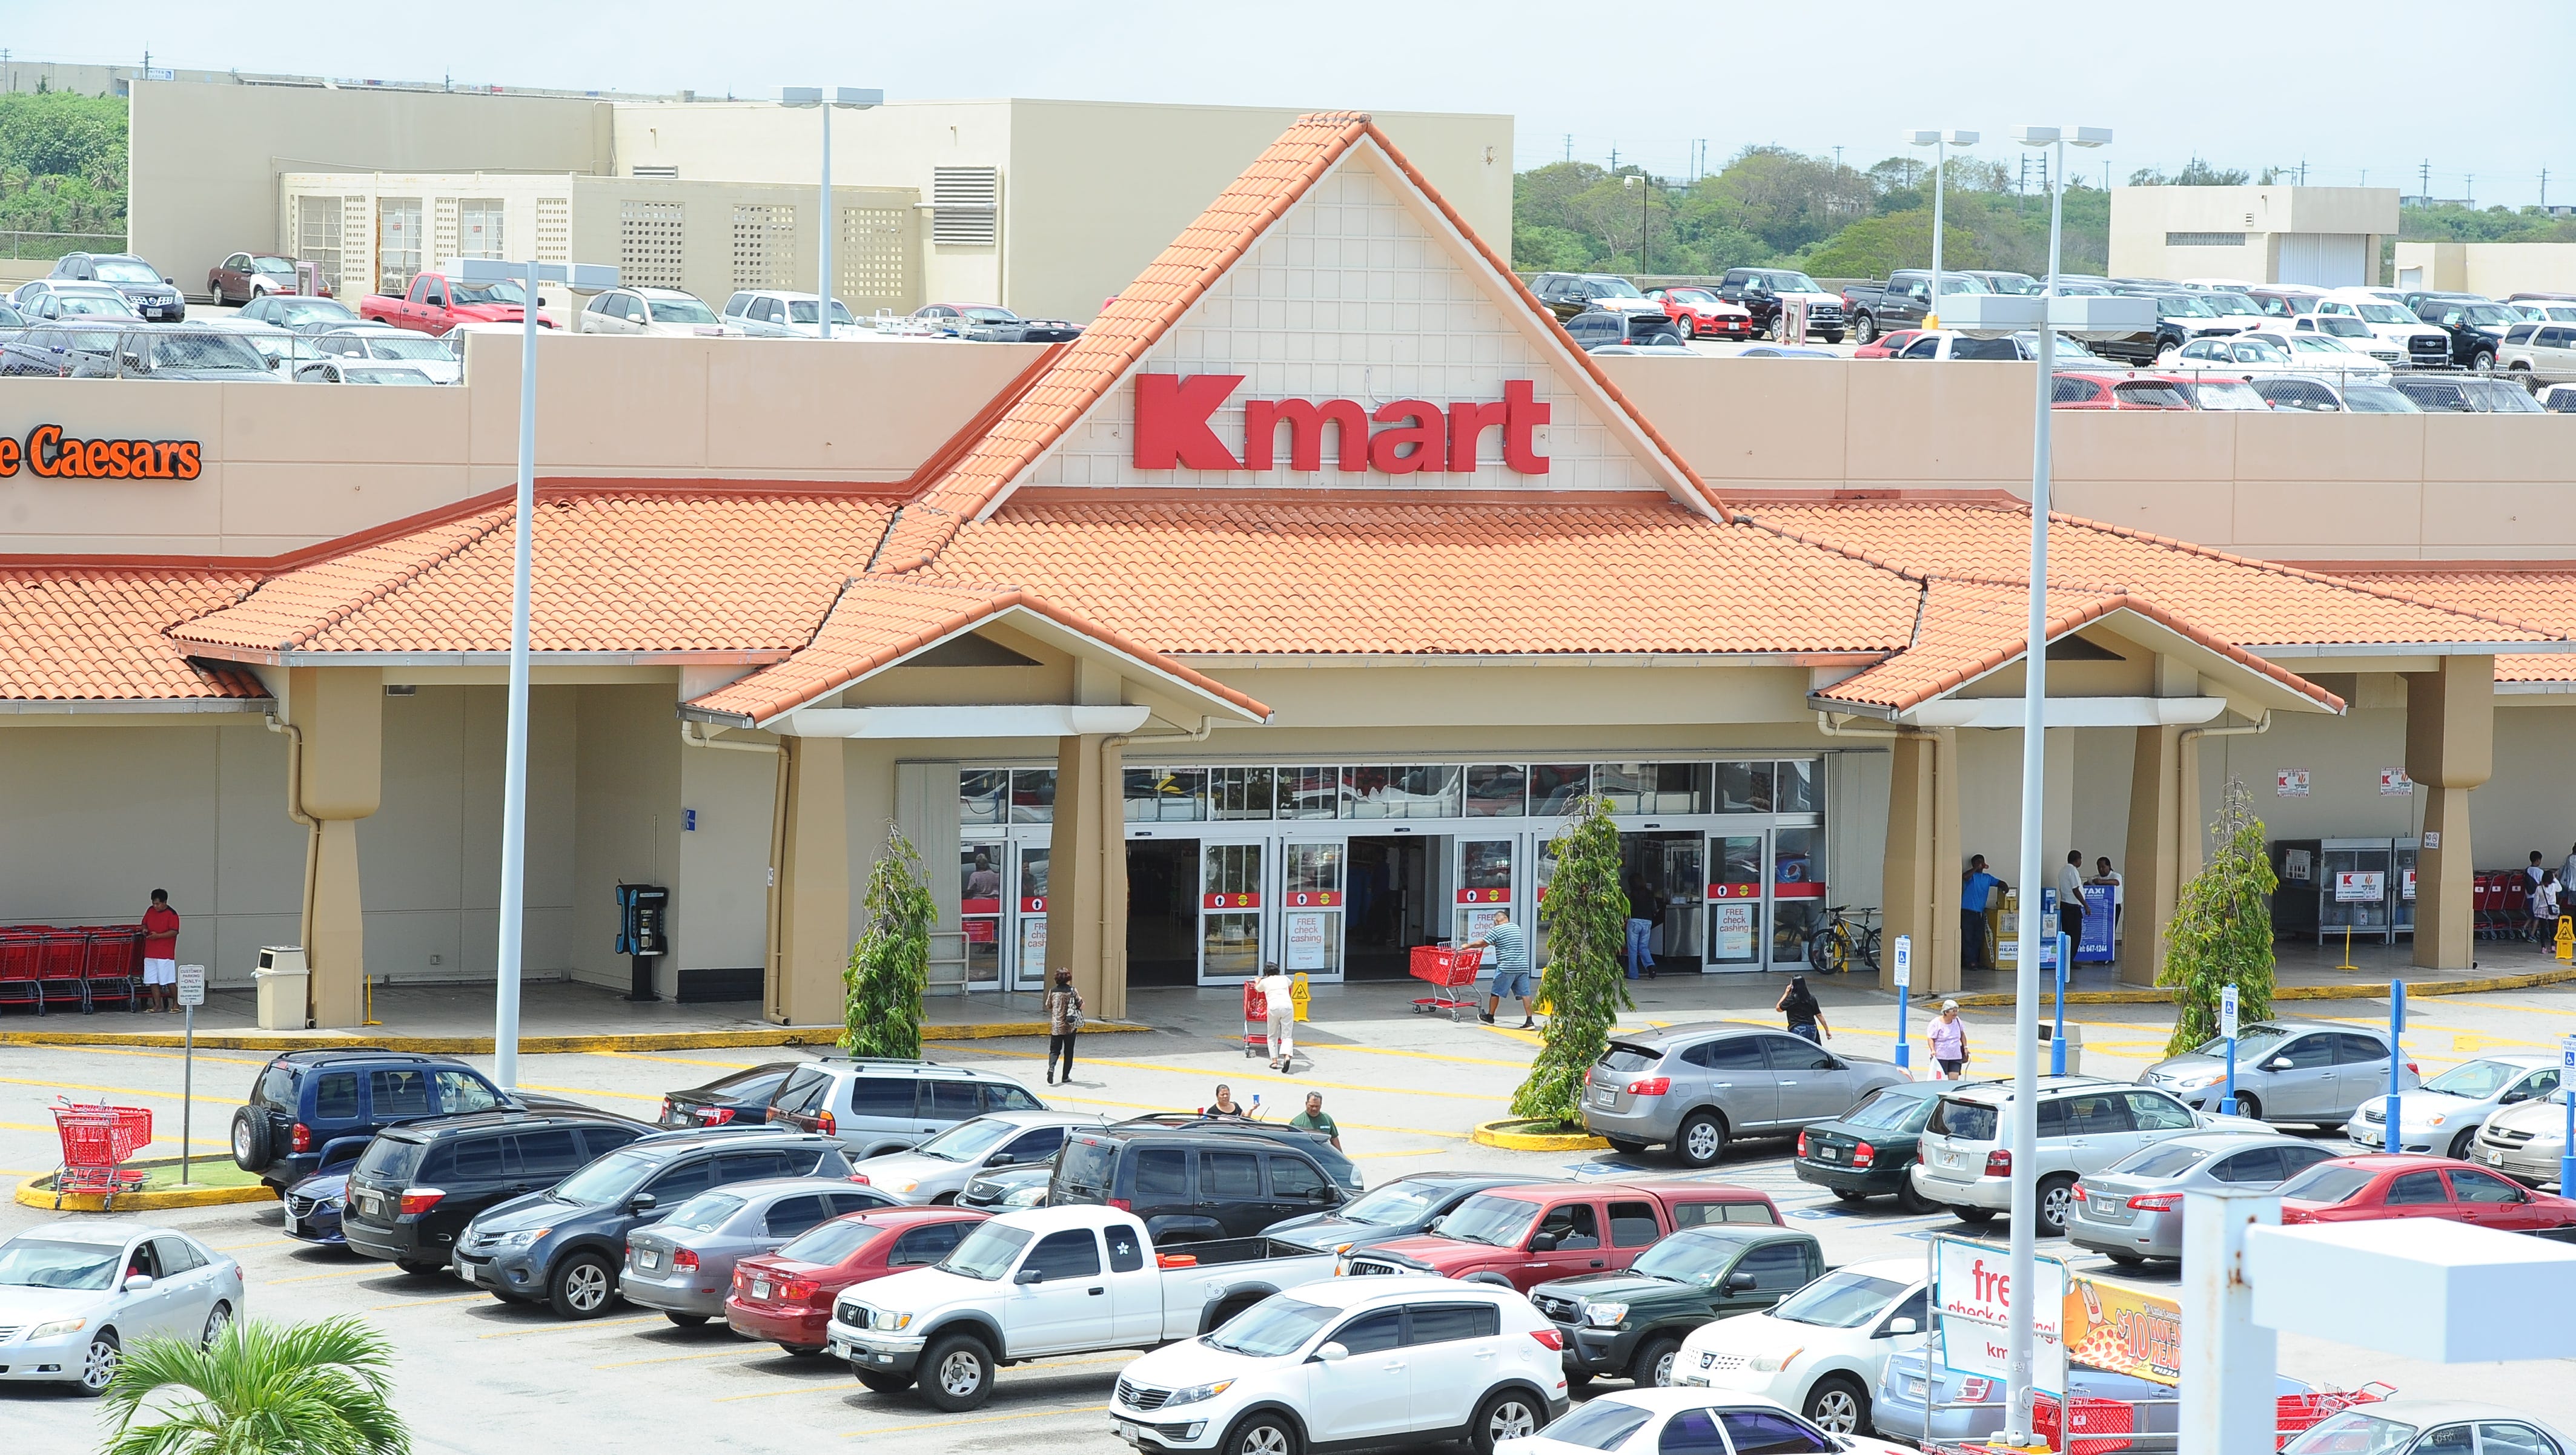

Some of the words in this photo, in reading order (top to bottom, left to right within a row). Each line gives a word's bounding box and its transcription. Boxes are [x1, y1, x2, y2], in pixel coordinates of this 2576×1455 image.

[1133, 373, 1551, 474] Kmart
[0, 437, 21, 478] e
[25, 424, 202, 480] Caesars
[2343, 875, 2353, 884] K
[1723, 916, 1746, 924] check
[1294, 925, 1318, 934] check
[1719, 924, 1749, 933] cashing
[1290, 934, 1322, 943] cashing
[1972, 1259, 2010, 1307] fre
[2116, 1308, 2151, 1361] $10
[2150, 1339, 2180, 1371] READ
[2153, 1366, 2178, 1377] PIZZA
